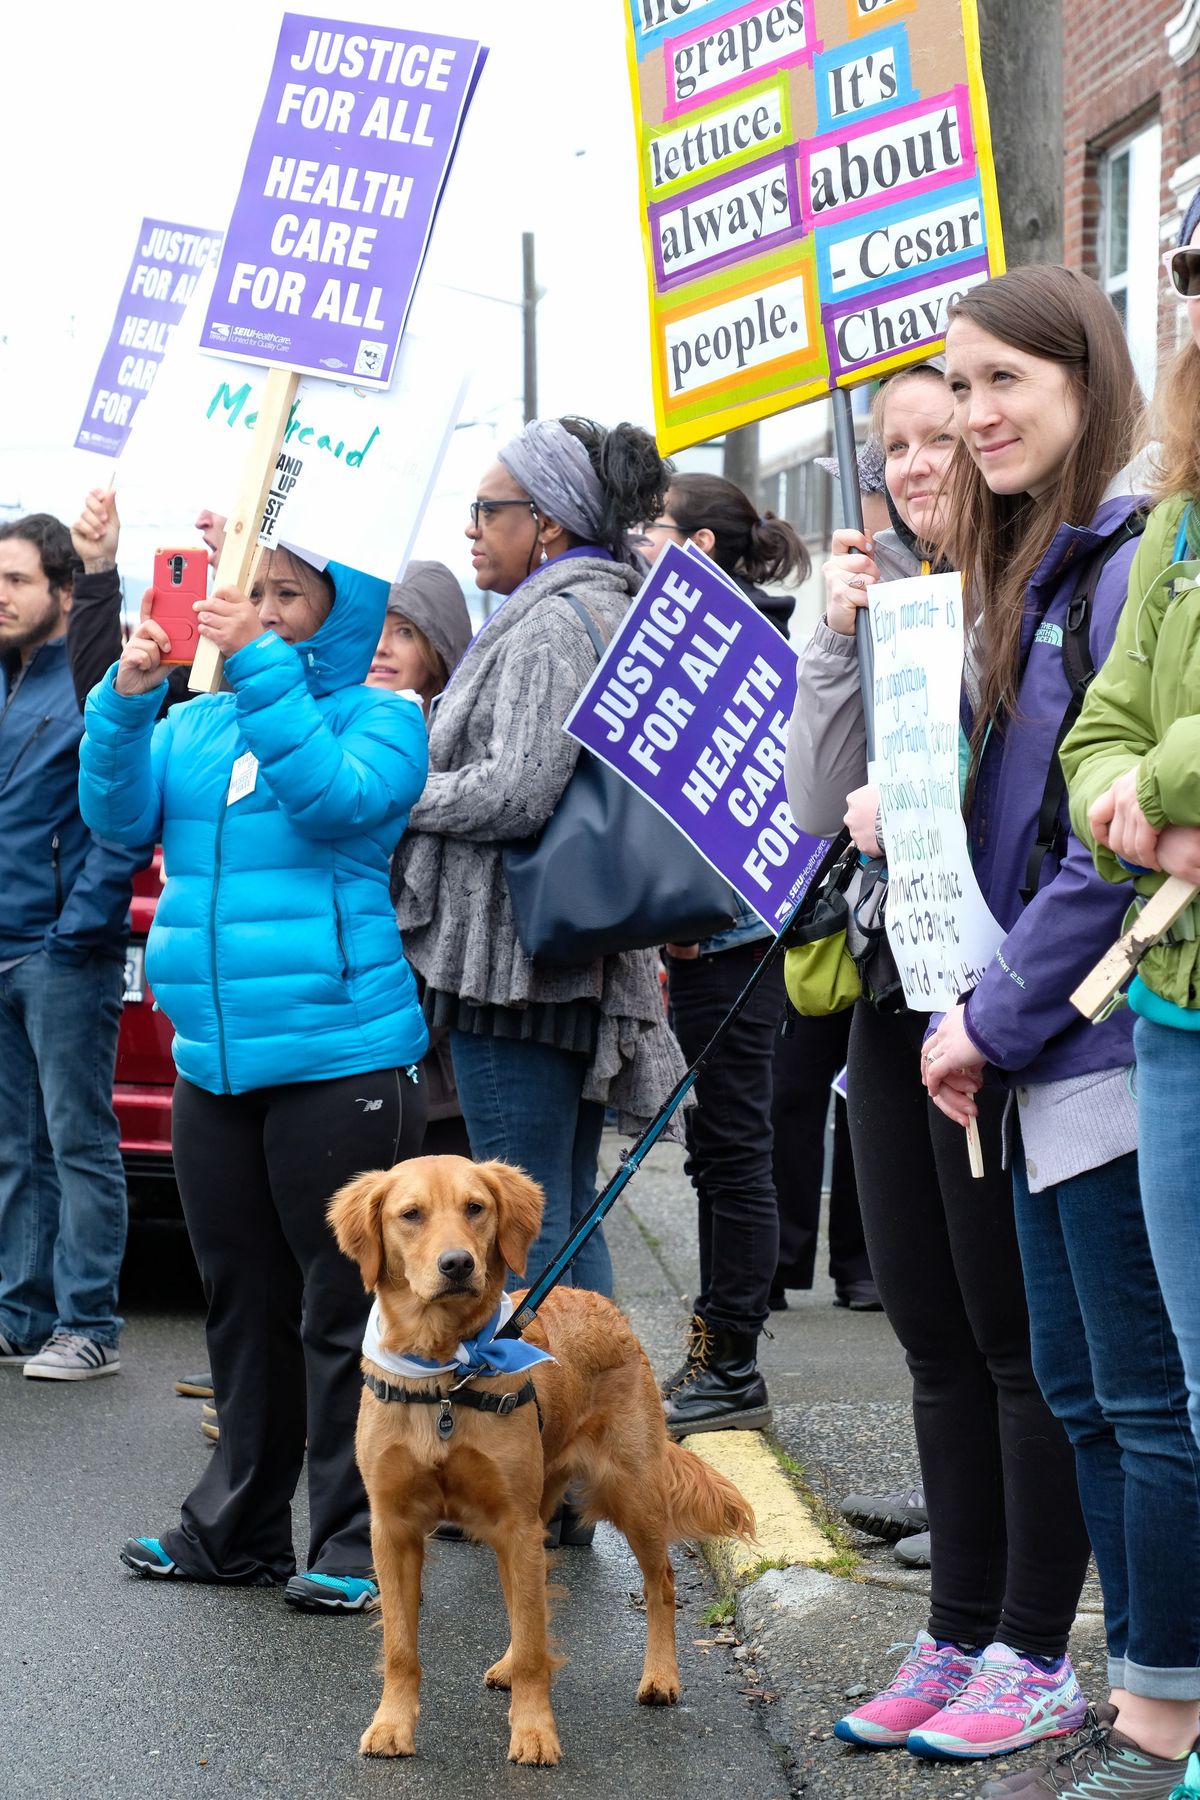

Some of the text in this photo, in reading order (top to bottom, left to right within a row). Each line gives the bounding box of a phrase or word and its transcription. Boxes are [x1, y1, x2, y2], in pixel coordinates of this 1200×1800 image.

[290, 30, 456, 92] JUSTICE
[674, 0, 804, 99] grapes
[276, 82, 434, 147] FOR ALL
[829, 55, 896, 117] It's
[651, 106, 781, 187] lettuce.
[811, 109, 959, 212] about
[263, 155, 414, 219] HEALTH
[141, 227, 222, 268] JUSTICE
[270, 213, 378, 270] CARE
[661, 176, 788, 263] always
[859, 210, 979, 279] Cesar
[130, 264, 173, 301] FOR
[227, 262, 384, 331] FOR ALL
[117, 355, 159, 391] CAR
[670, 297, 798, 391] people.
[91, 389, 133, 427] FOR
[275, 452, 303, 477] AND
[278, 474, 296, 493] UP
[900, 594, 939, 630] moment
[945, 595, 956, 628] is
[593, 570, 702, 742] JUSTICE
[628, 612, 742, 776] FOR ALL
[681, 654, 783, 816] HEALTH
[742, 801, 800, 892] FOR
[892, 916, 905, 945] to
